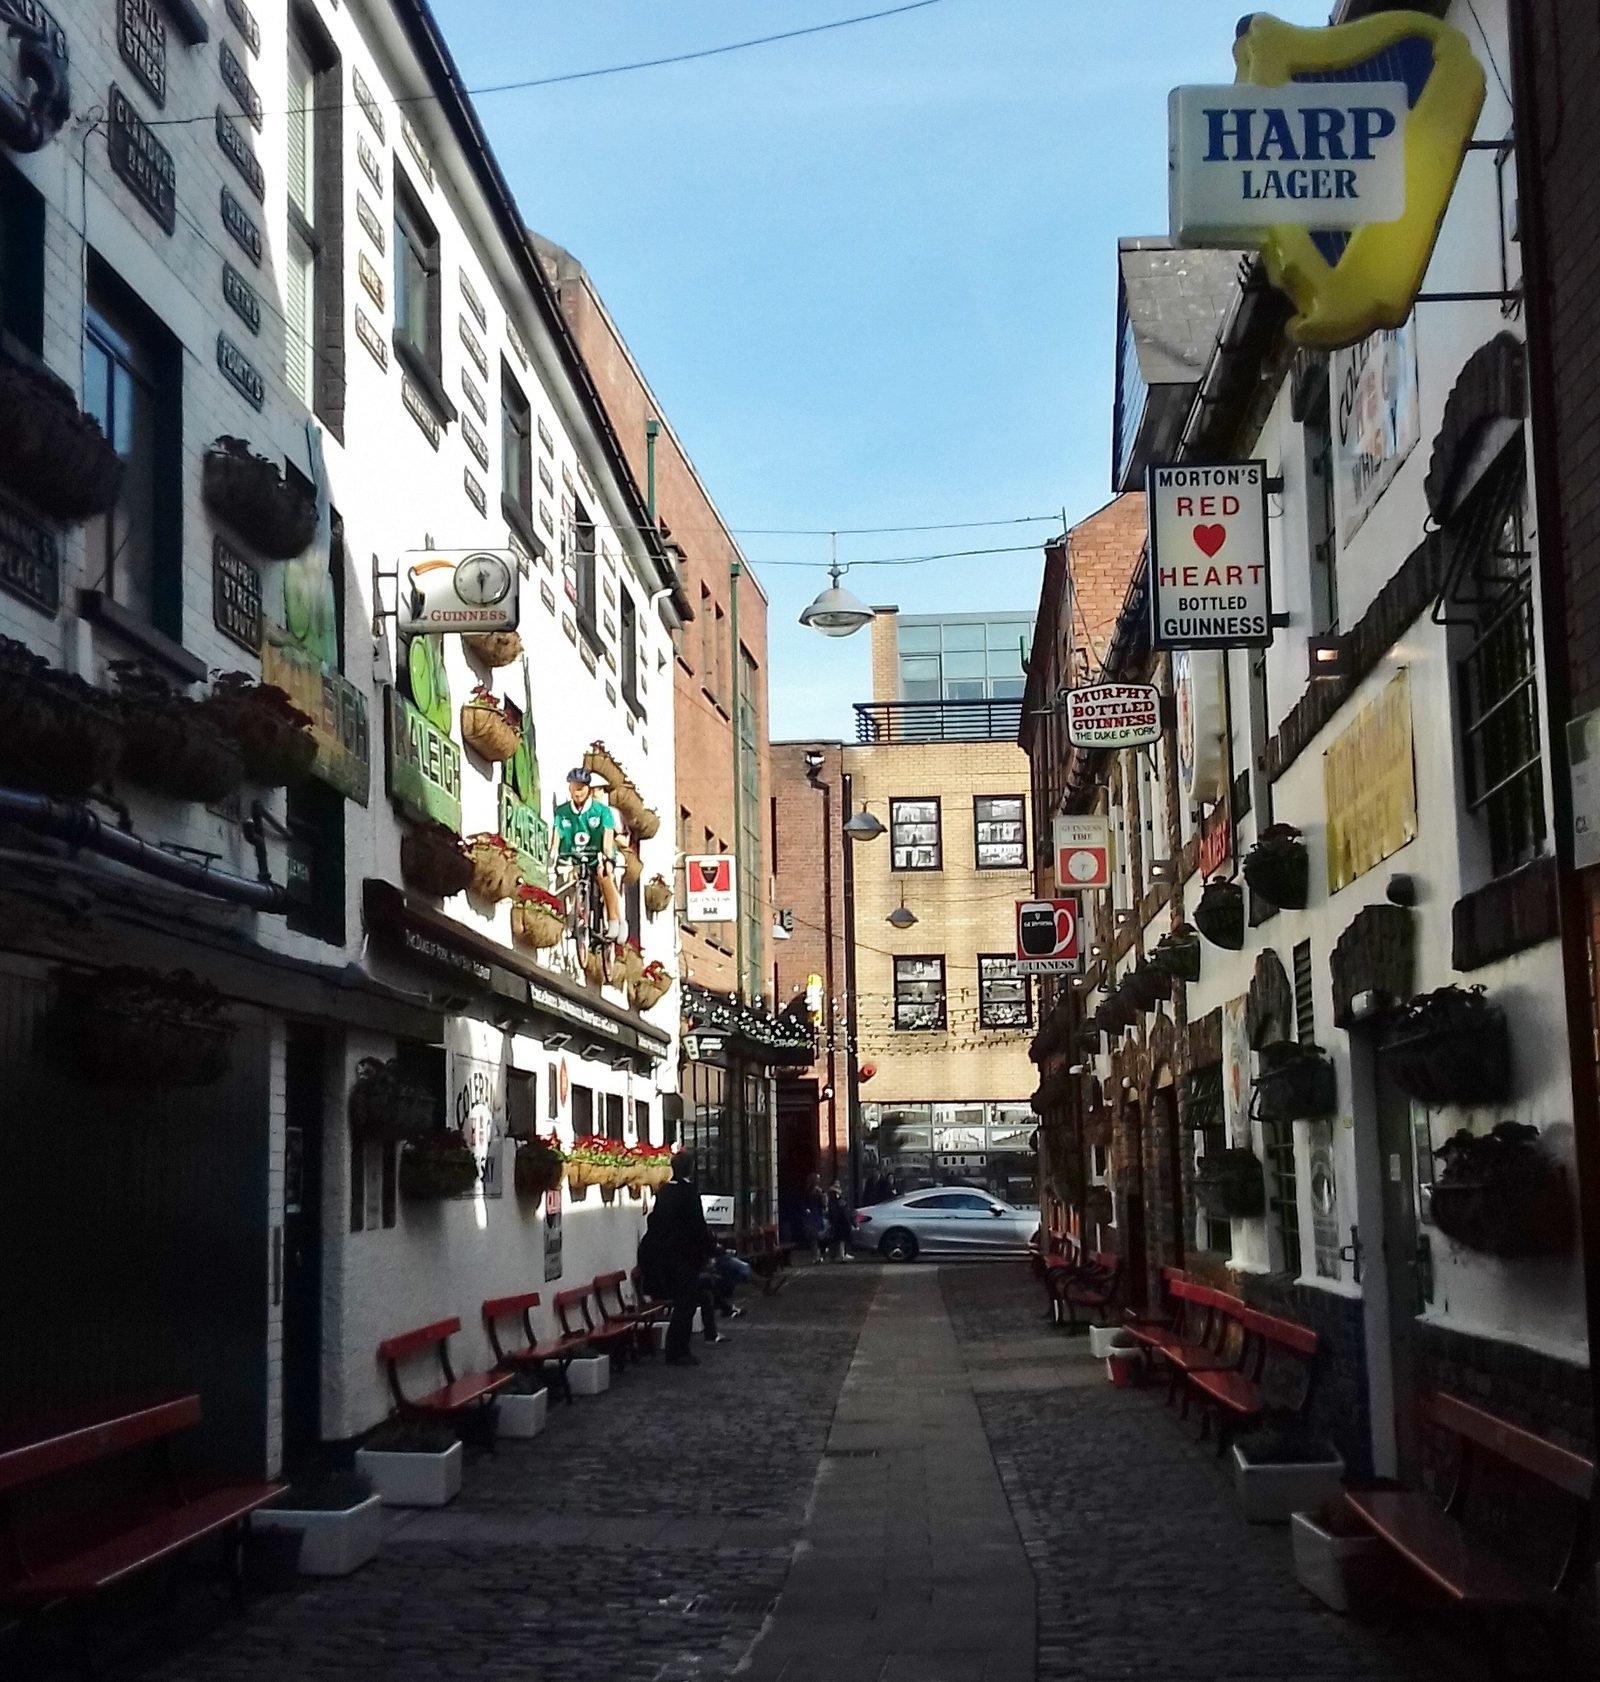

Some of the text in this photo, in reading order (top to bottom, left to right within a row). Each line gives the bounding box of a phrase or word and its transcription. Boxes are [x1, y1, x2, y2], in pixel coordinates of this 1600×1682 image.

[1202, 107, 1396, 161] HARP
[1242, 169, 1359, 199] LAGER
[1159, 468, 1259, 488] MORTON'S
[1177, 495, 1240, 517] RED
[1160, 564, 1264, 588] HEART
[1179, 596, 1247, 611] BOTTLED
[430, 609, 507, 623] GUINNESS
[1164, 615, 1265, 636] GUINNESS
[1072, 687, 1153, 704] MURPHY
[1072, 701, 1154, 718] BOTTLED
[1072, 713, 1156, 730] GUINNESS
[1075, 726, 1155, 740] THE DUKE OF YORK
